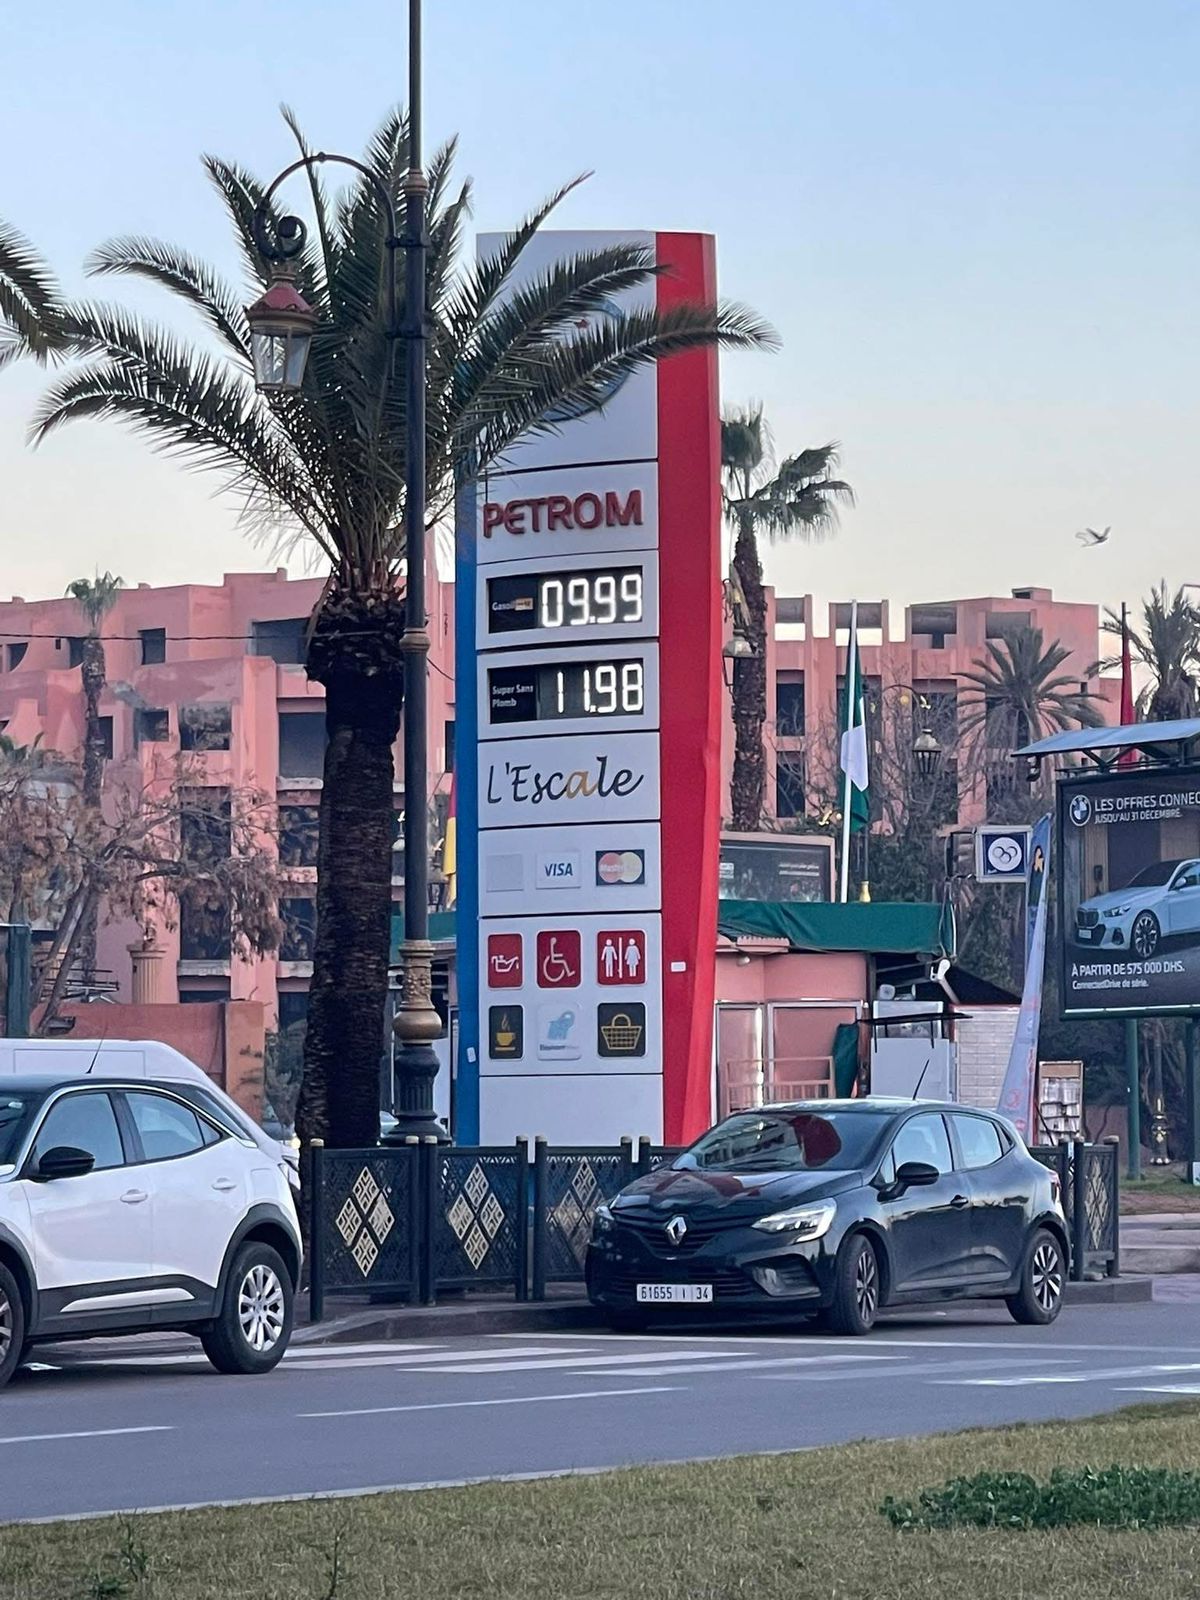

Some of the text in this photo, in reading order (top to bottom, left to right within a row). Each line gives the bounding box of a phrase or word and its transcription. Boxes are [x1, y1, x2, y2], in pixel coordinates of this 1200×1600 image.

[483, 490, 643, 538] PETROM
[492, 684, 533, 695] Super Sans
[557, 664, 643, 713] 11.98
[492, 698, 517, 708] Plomb
[487, 756, 644, 804] L'Escale
[1094, 799, 1114, 812] LES
[1116, 796, 1156, 810] OFFRES
[1094, 813, 1131, 825] JUSQU'AU
[1131, 812, 1139, 821] 31
[545, 863, 573, 876] VISA
[1072, 961, 1185, 977] À PARTIR DE 575 000 DHS.
[1122, 979, 1130, 988] de
[641, 1286, 673, 1300] 61655
[696, 1286, 708, 1300] 34
